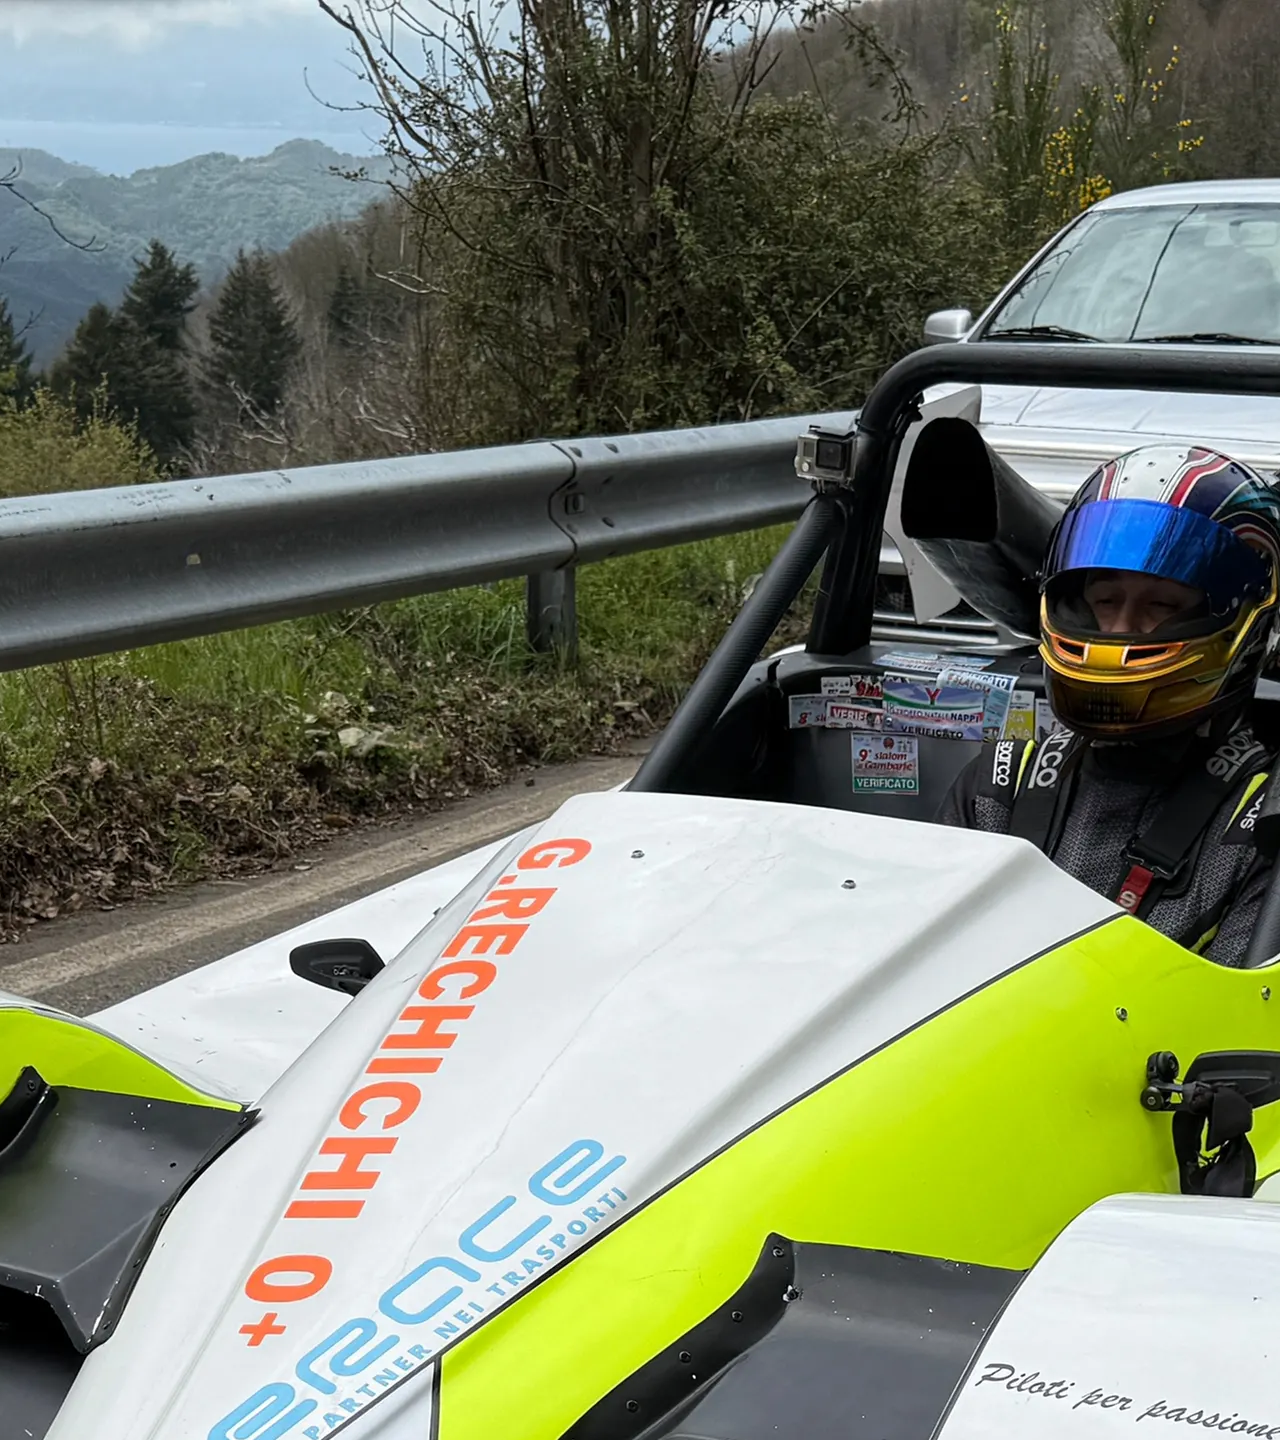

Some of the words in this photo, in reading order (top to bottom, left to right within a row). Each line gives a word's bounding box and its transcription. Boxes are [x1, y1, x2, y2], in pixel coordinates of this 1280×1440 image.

[901, 725, 964, 739] VERIFICATO
[874, 750, 908, 762] slalom
[856, 777, 915, 789] VERIFICATO
[283, 837, 593, 1220] G.RECHICHI
[432, 1300, 486, 1341] NEI
[485, 1186, 629, 1298] TRASPORTI
[974, 1362, 1076, 1401] Piloti
[1071, 1387, 1134, 1411] per
